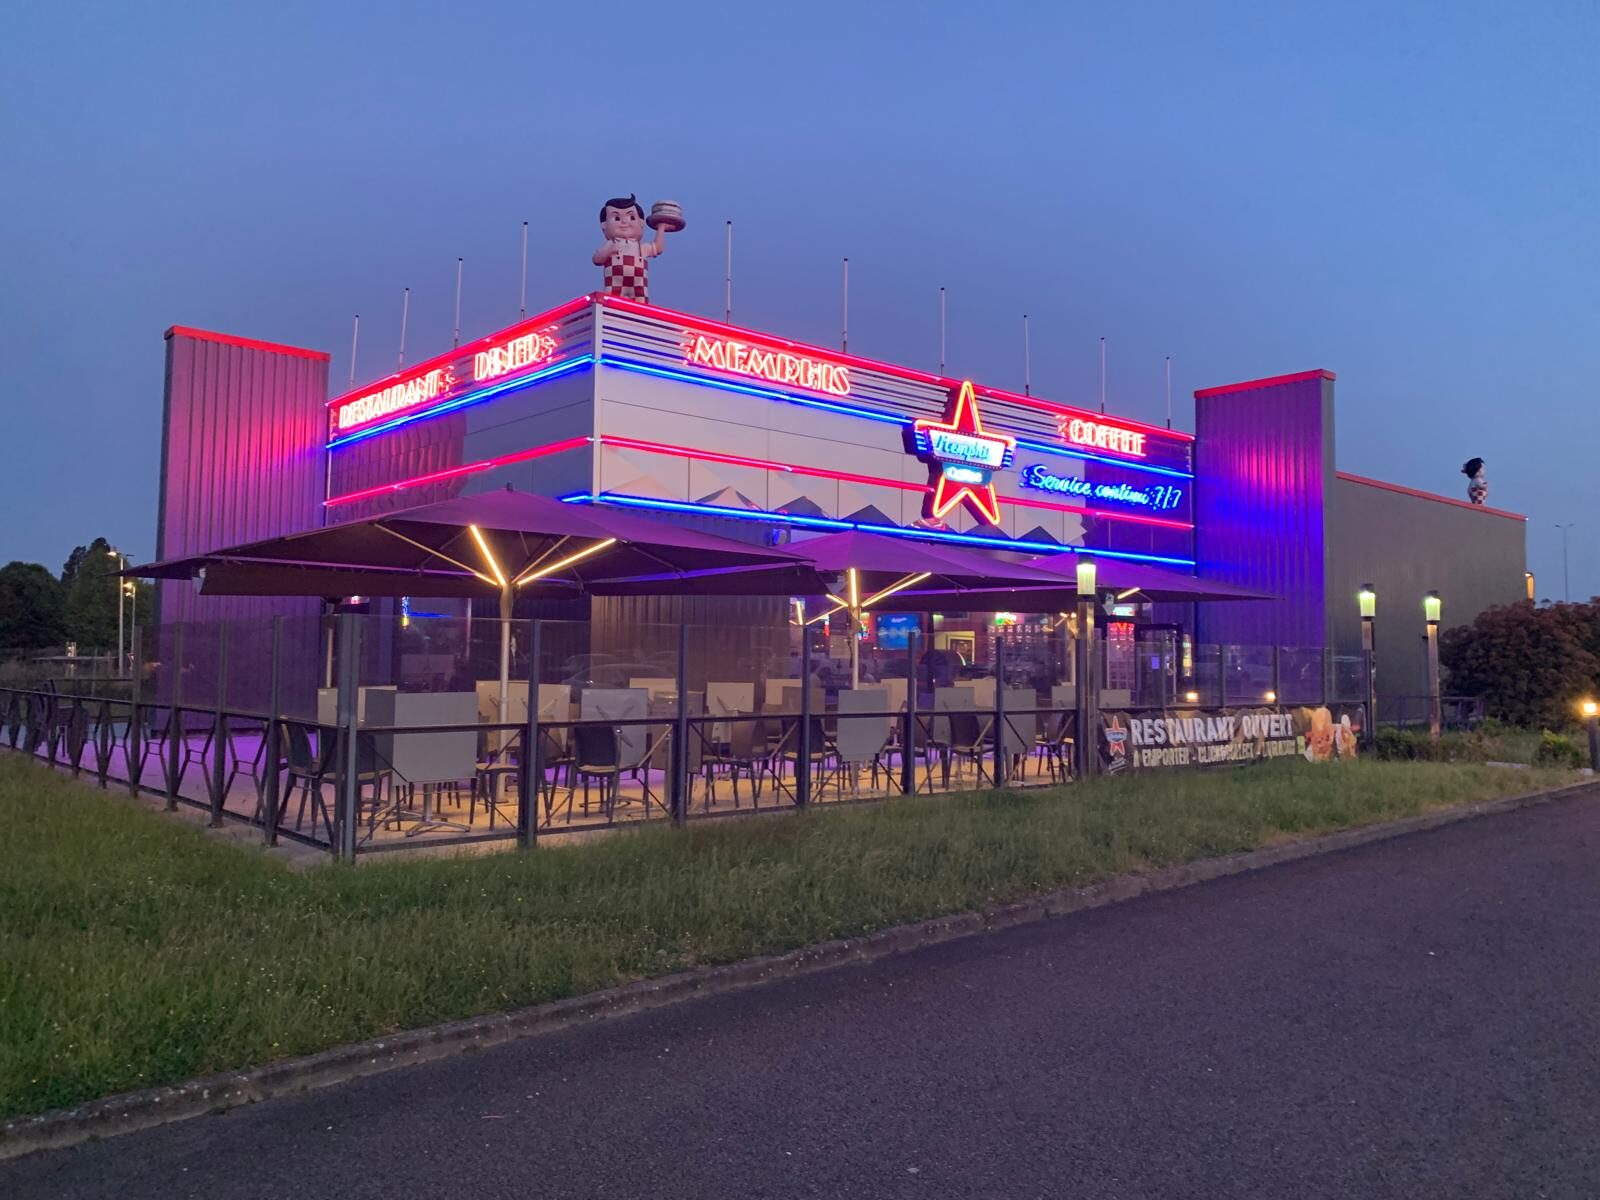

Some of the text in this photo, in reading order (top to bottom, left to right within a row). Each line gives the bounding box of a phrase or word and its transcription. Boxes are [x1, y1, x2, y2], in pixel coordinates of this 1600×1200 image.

[339, 333, 541, 429] RESTAURANT DINER
[693, 335, 850, 395] MEMPHIS
[1070, 418, 1146, 457] COFFEE
[1030, 464, 1091, 496] Service
[1130, 713, 1293, 747] RESTAURANT OUVERT
[1142, 748, 1190, 767] EMPORTER
